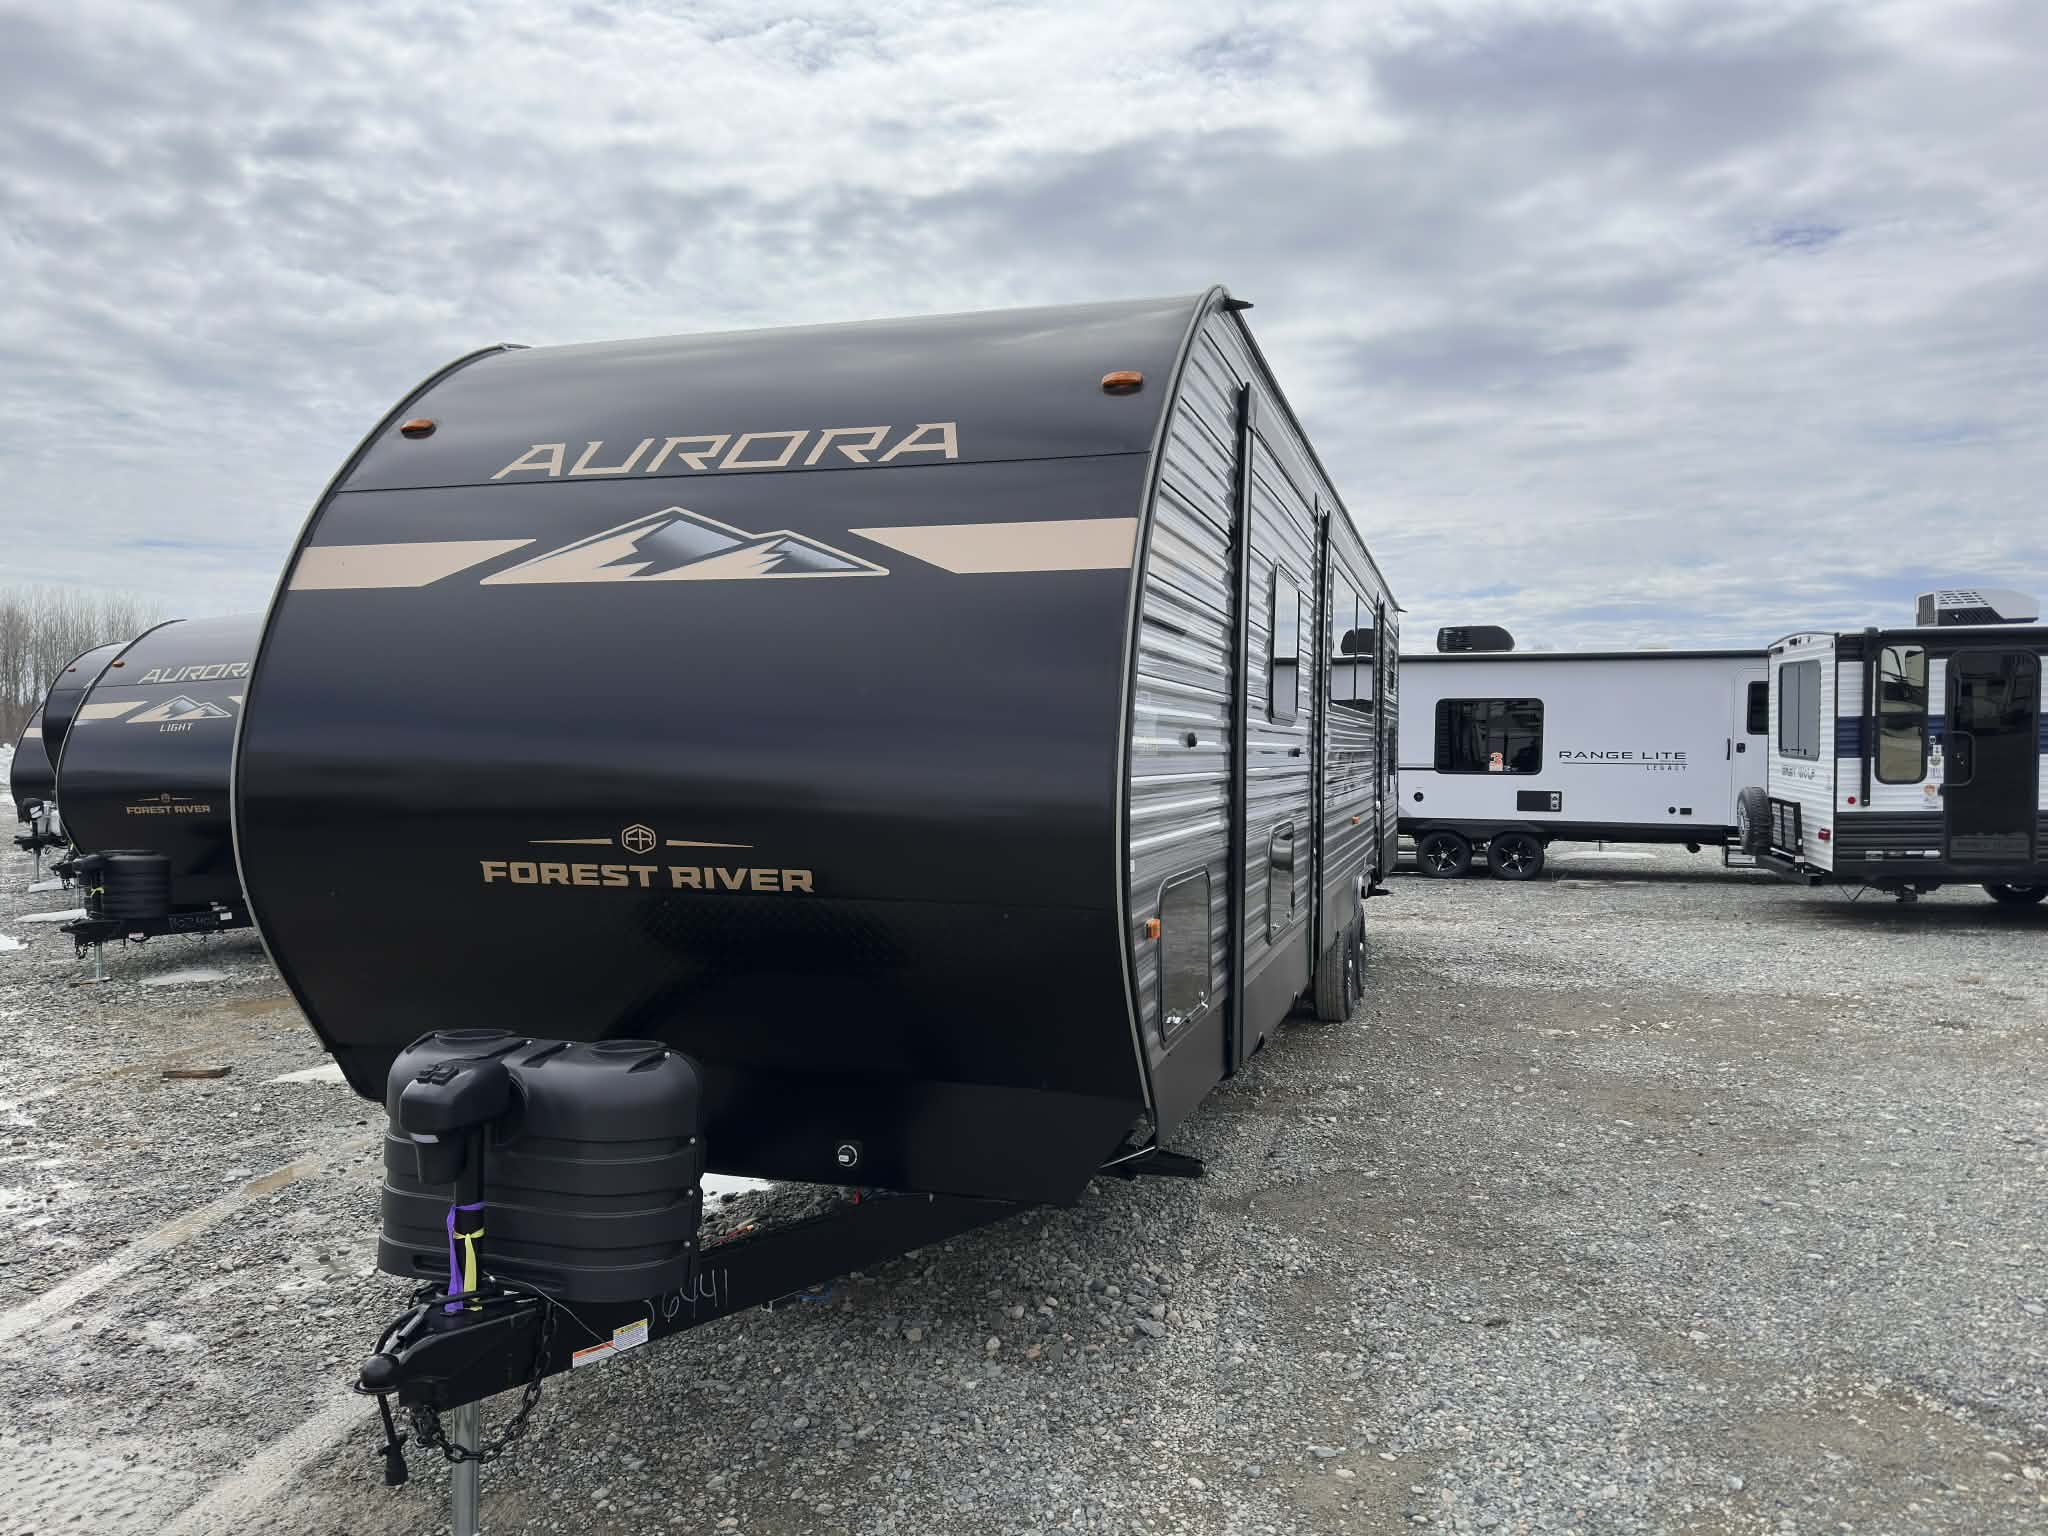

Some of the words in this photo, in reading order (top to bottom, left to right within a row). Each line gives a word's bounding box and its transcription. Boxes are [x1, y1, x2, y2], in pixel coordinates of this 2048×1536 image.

[490, 422, 959, 480] AURORA
[137, 663, 249, 684] AUROR
[160, 723, 192, 732] LIGHT
[1559, 751, 1633, 760] RANGE
[1642, 752, 1687, 760] LITE
[126, 805, 172, 814] FOREST
[174, 805, 210, 813] RIVER
[480, 860, 659, 888] FOREST
[667, 865, 816, 893] RIVER
